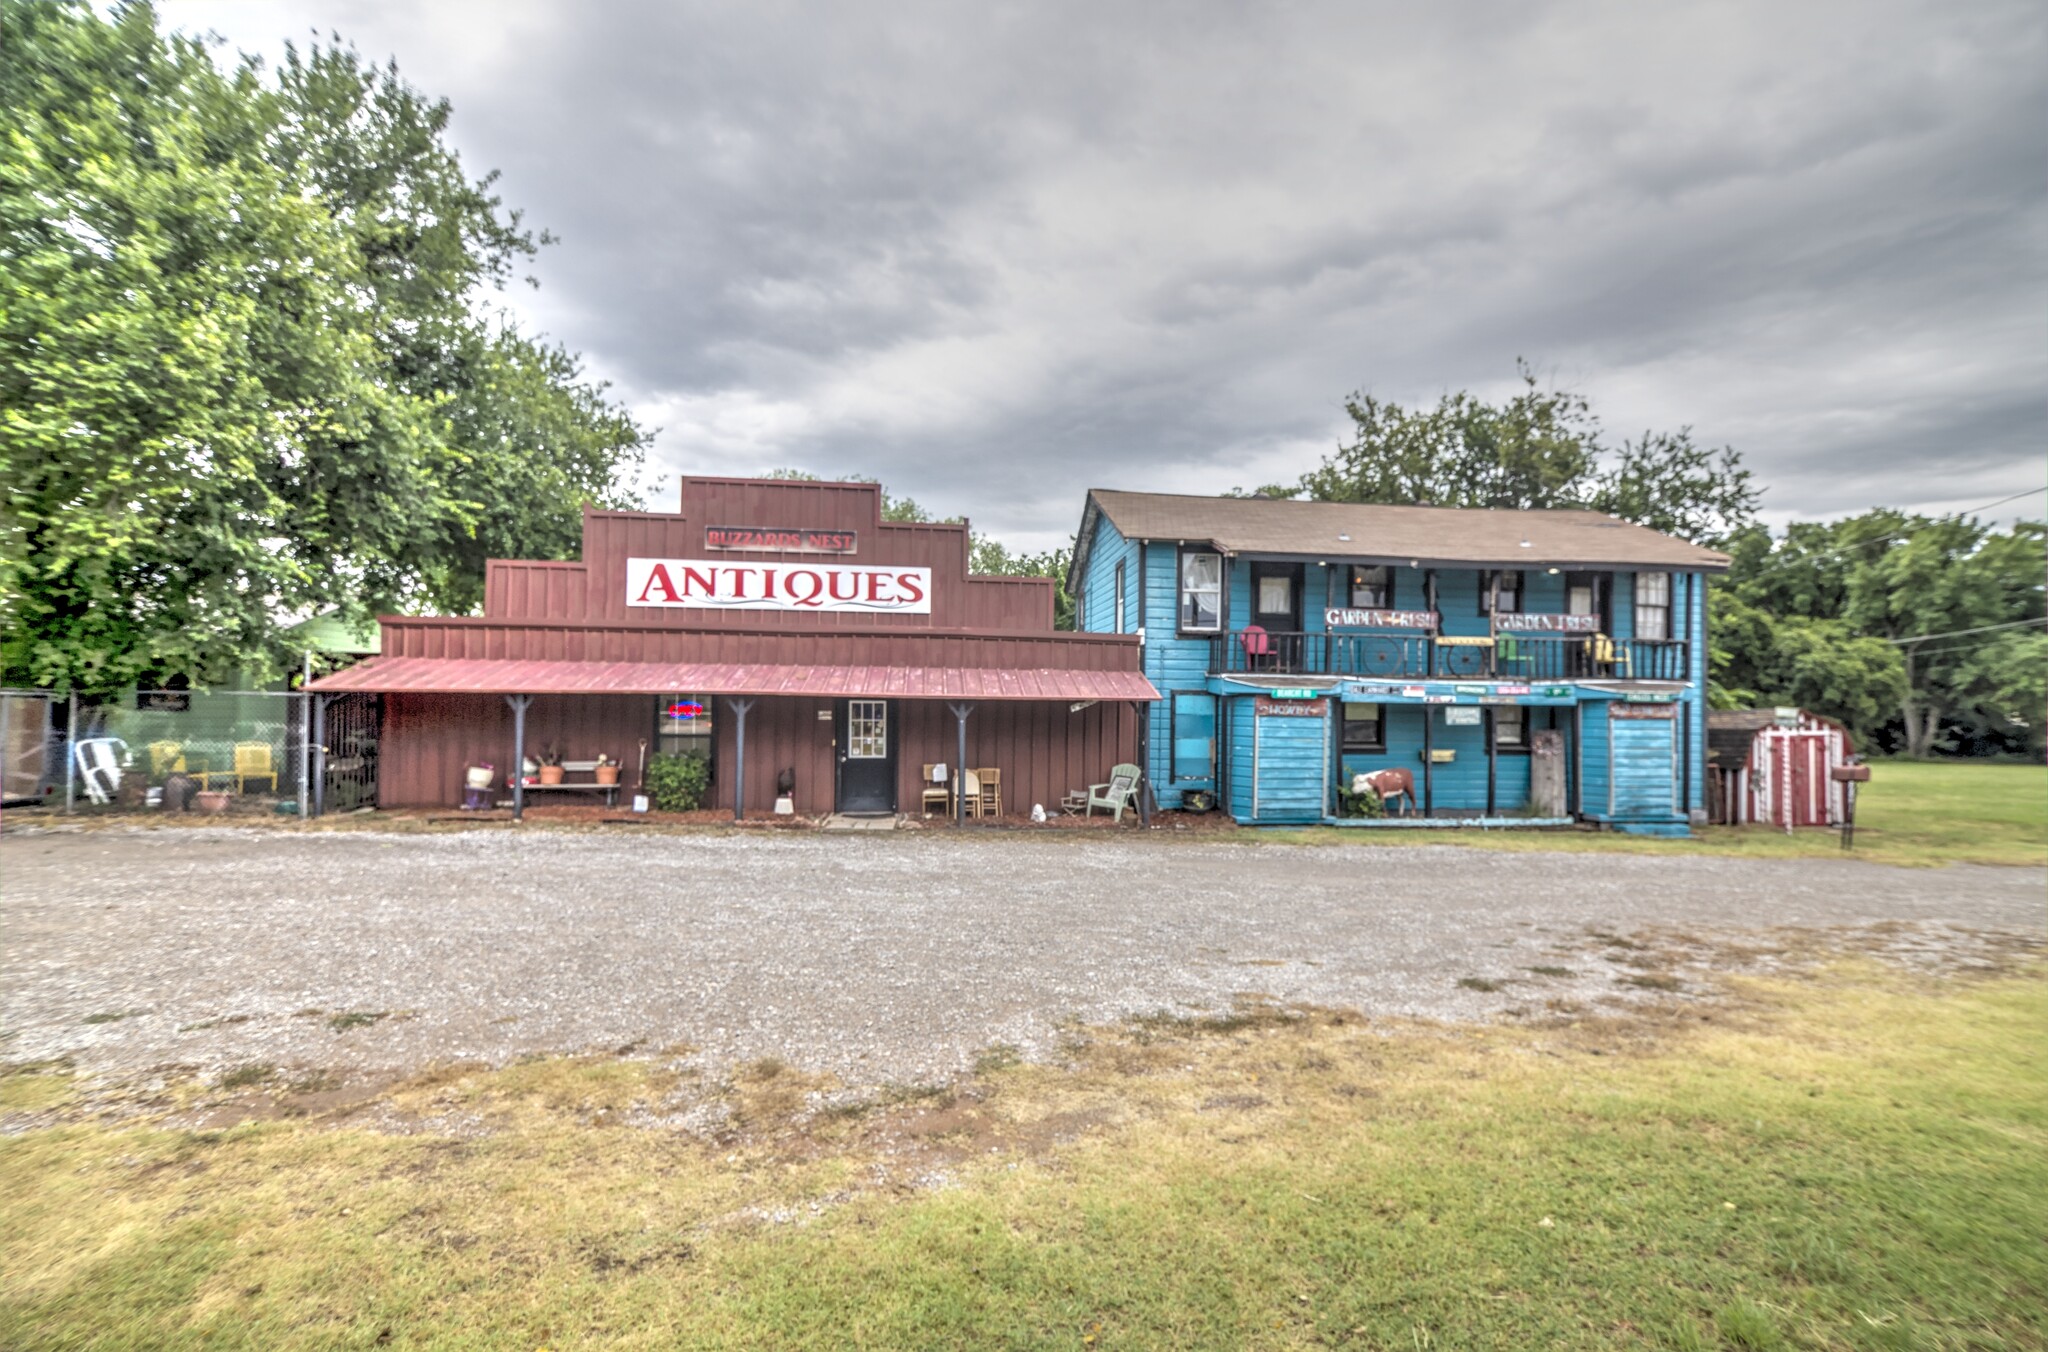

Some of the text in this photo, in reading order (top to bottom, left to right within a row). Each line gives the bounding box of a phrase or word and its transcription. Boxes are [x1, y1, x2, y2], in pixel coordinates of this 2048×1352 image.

[708, 531, 853, 549] BUZZARDS NEST
[636, 563, 924, 607] ANTIQUES
[1326, 609, 1383, 626] GARDEN
[1496, 614, 1552, 630] GARDEN
